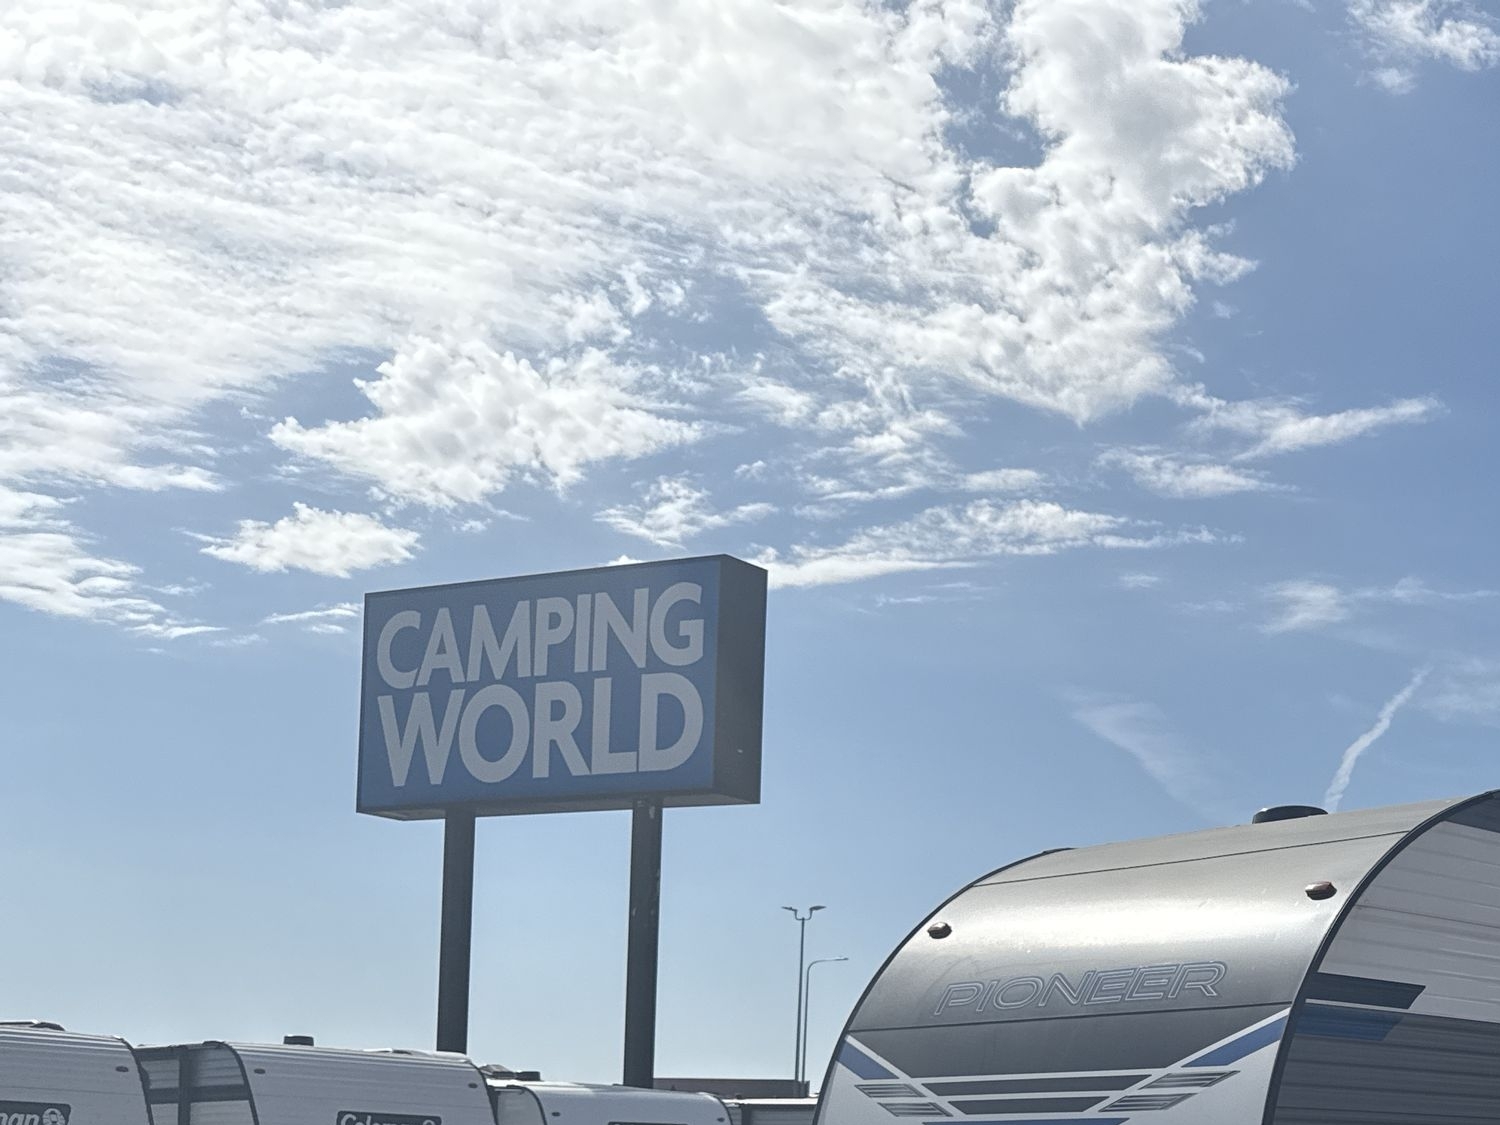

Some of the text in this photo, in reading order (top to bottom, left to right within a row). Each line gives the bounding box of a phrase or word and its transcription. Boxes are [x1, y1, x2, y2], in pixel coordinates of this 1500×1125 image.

[377, 582, 704, 689] CAMPING
[377, 672, 703, 787] WORLD
[934, 961, 1227, 1016] PIONEER
